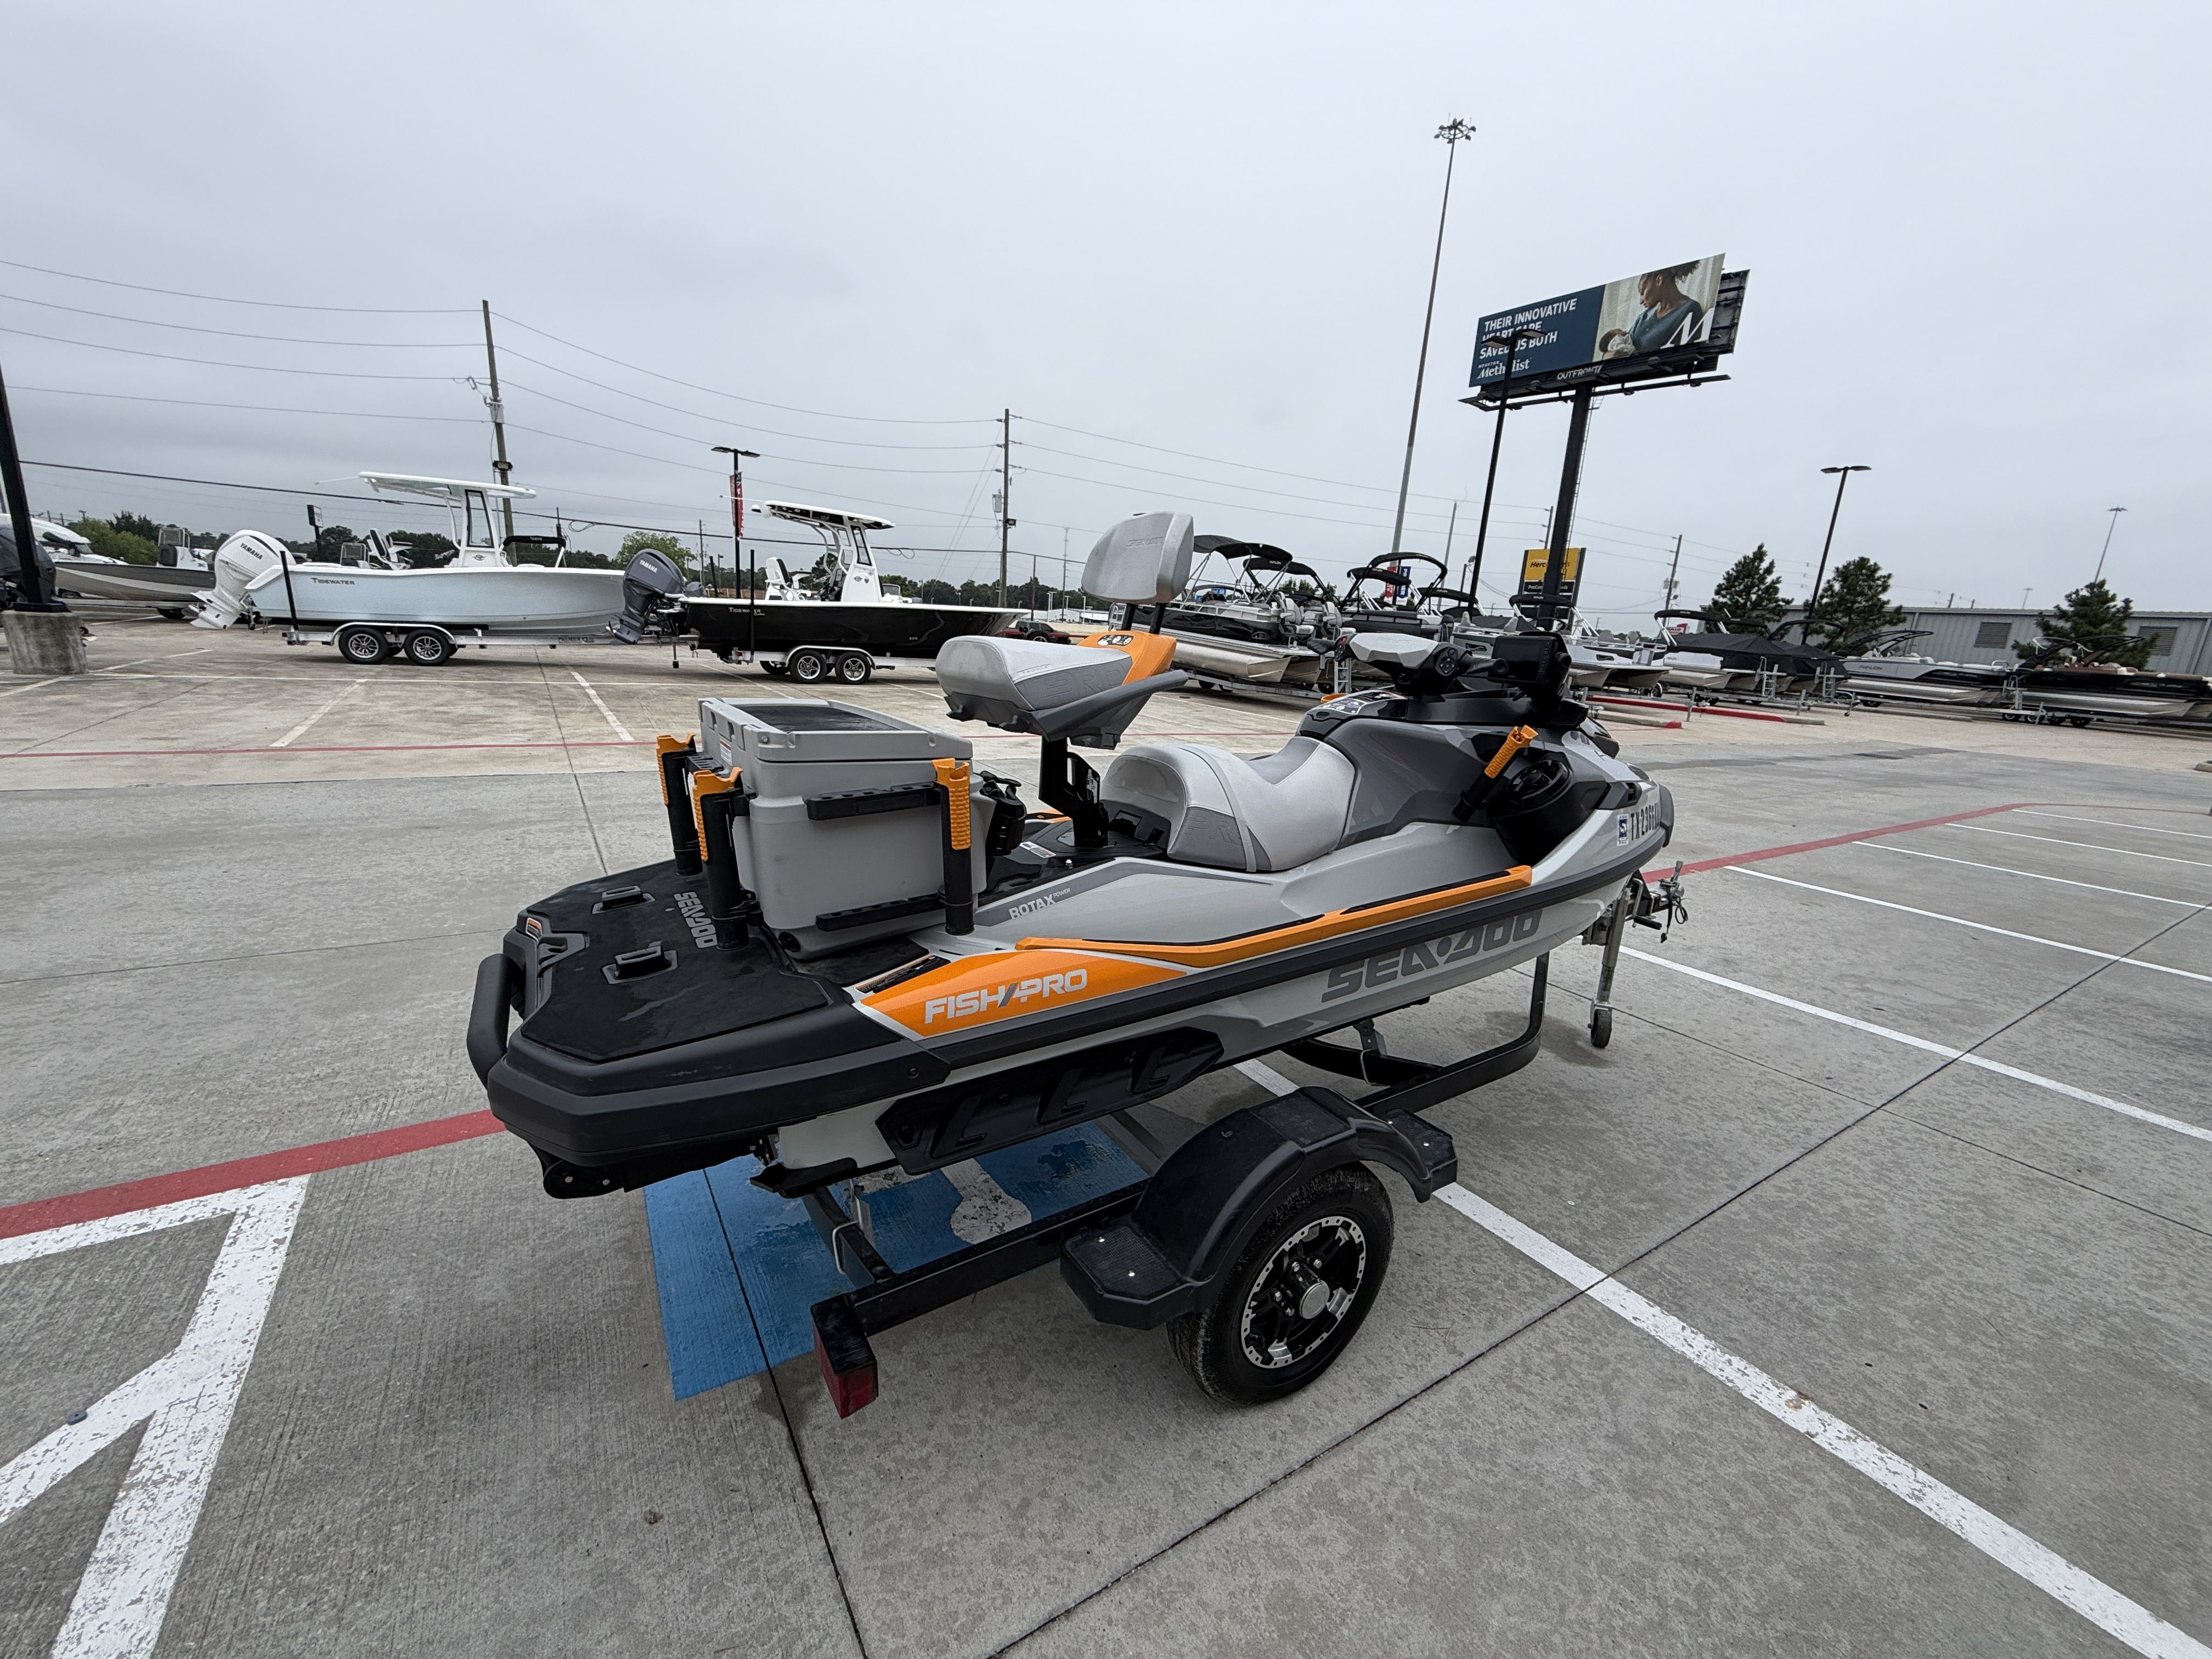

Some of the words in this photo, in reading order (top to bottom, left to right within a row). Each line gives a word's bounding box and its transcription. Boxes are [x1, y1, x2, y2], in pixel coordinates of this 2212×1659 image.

[1485, 316, 1512, 332] THEIR
[1515, 298, 1578, 325] INNOVATIVE
[1660, 307, 1716, 349] M
[1528, 331, 1558, 348] BOTH
[1476, 359, 1531, 379] Methist
[240, 543, 263, 560] YAMAHA
[639, 559, 658, 574] YAMAHA
[1009, 894, 1056, 920] ROTAX
[1053, 888, 1071, 898] POWER
